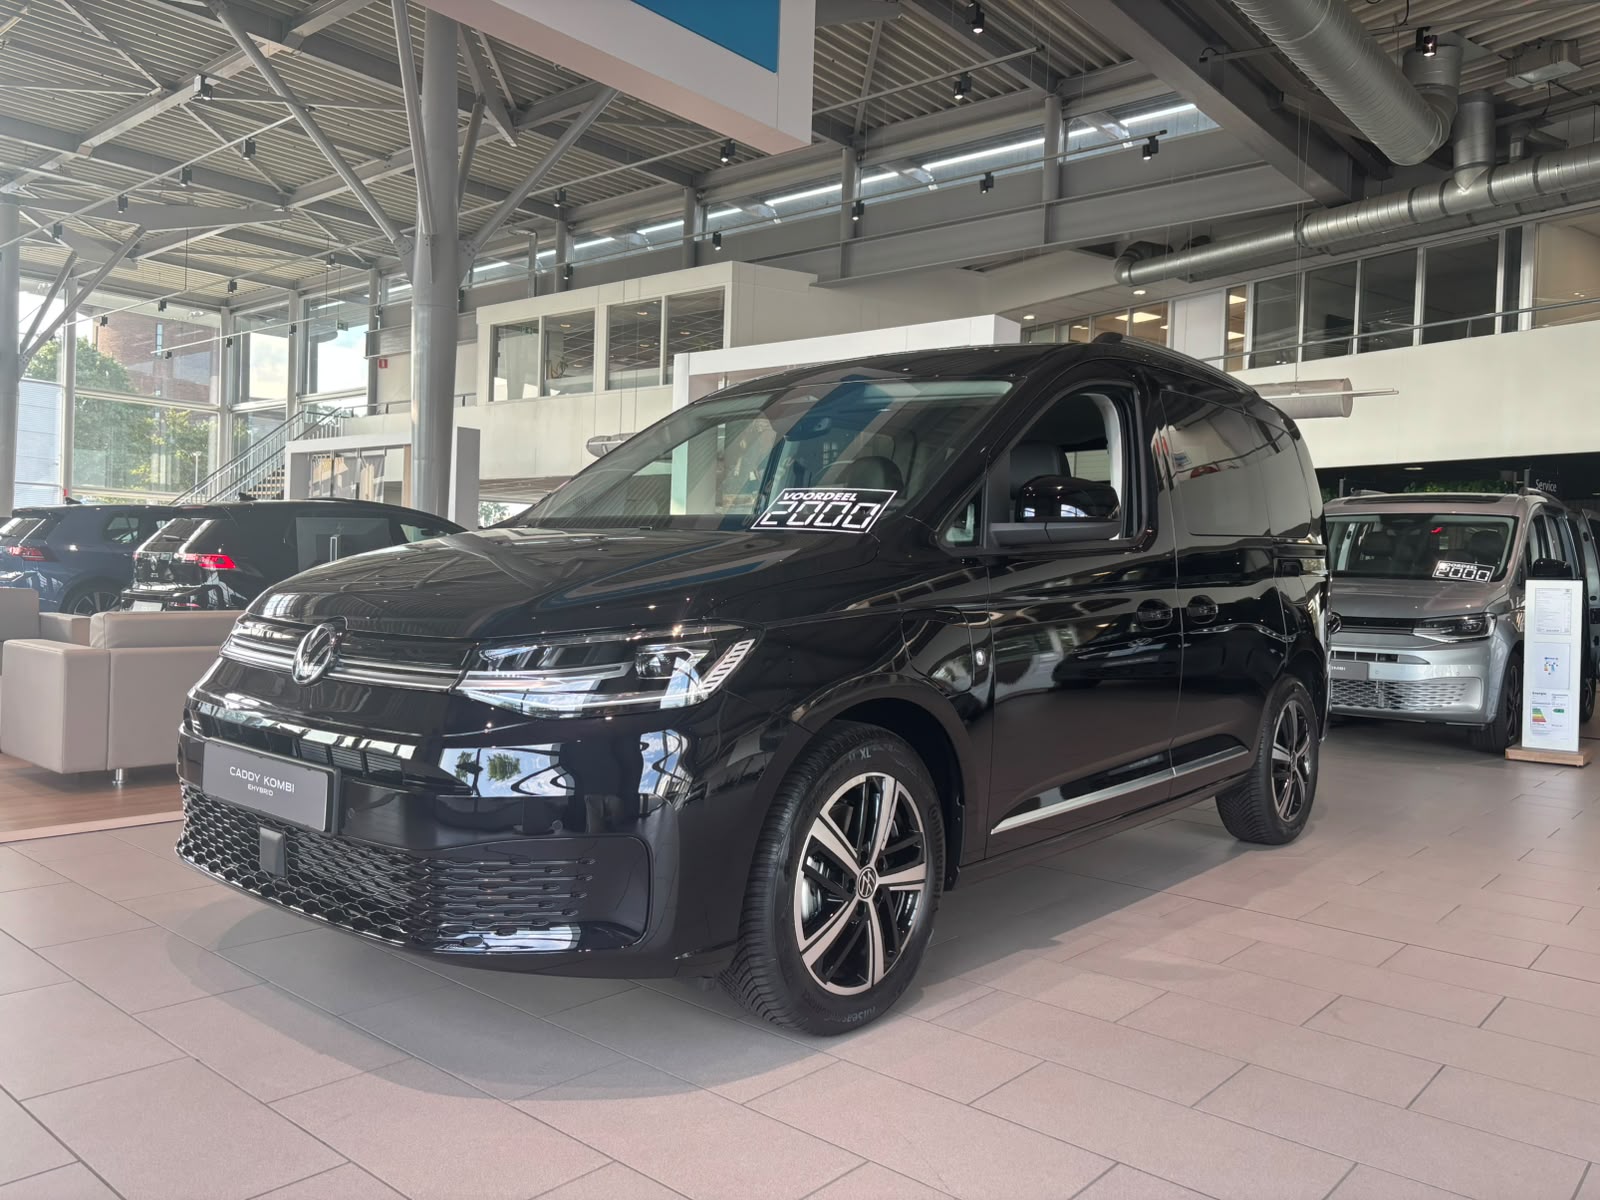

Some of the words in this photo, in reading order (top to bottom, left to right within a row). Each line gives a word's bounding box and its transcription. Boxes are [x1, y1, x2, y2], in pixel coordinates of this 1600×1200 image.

[1535, 478, 1557, 492] Service
[783, 491, 858, 501] VOORDEEL
[760, 501, 881, 529] 2000
[1435, 566, 1490, 581] 2000
[860, 747, 872, 760] XL
[229, 766, 261, 783] CADDY
[263, 775, 295, 793] KOMBI
[247, 783, 274, 797] EHYBRID
